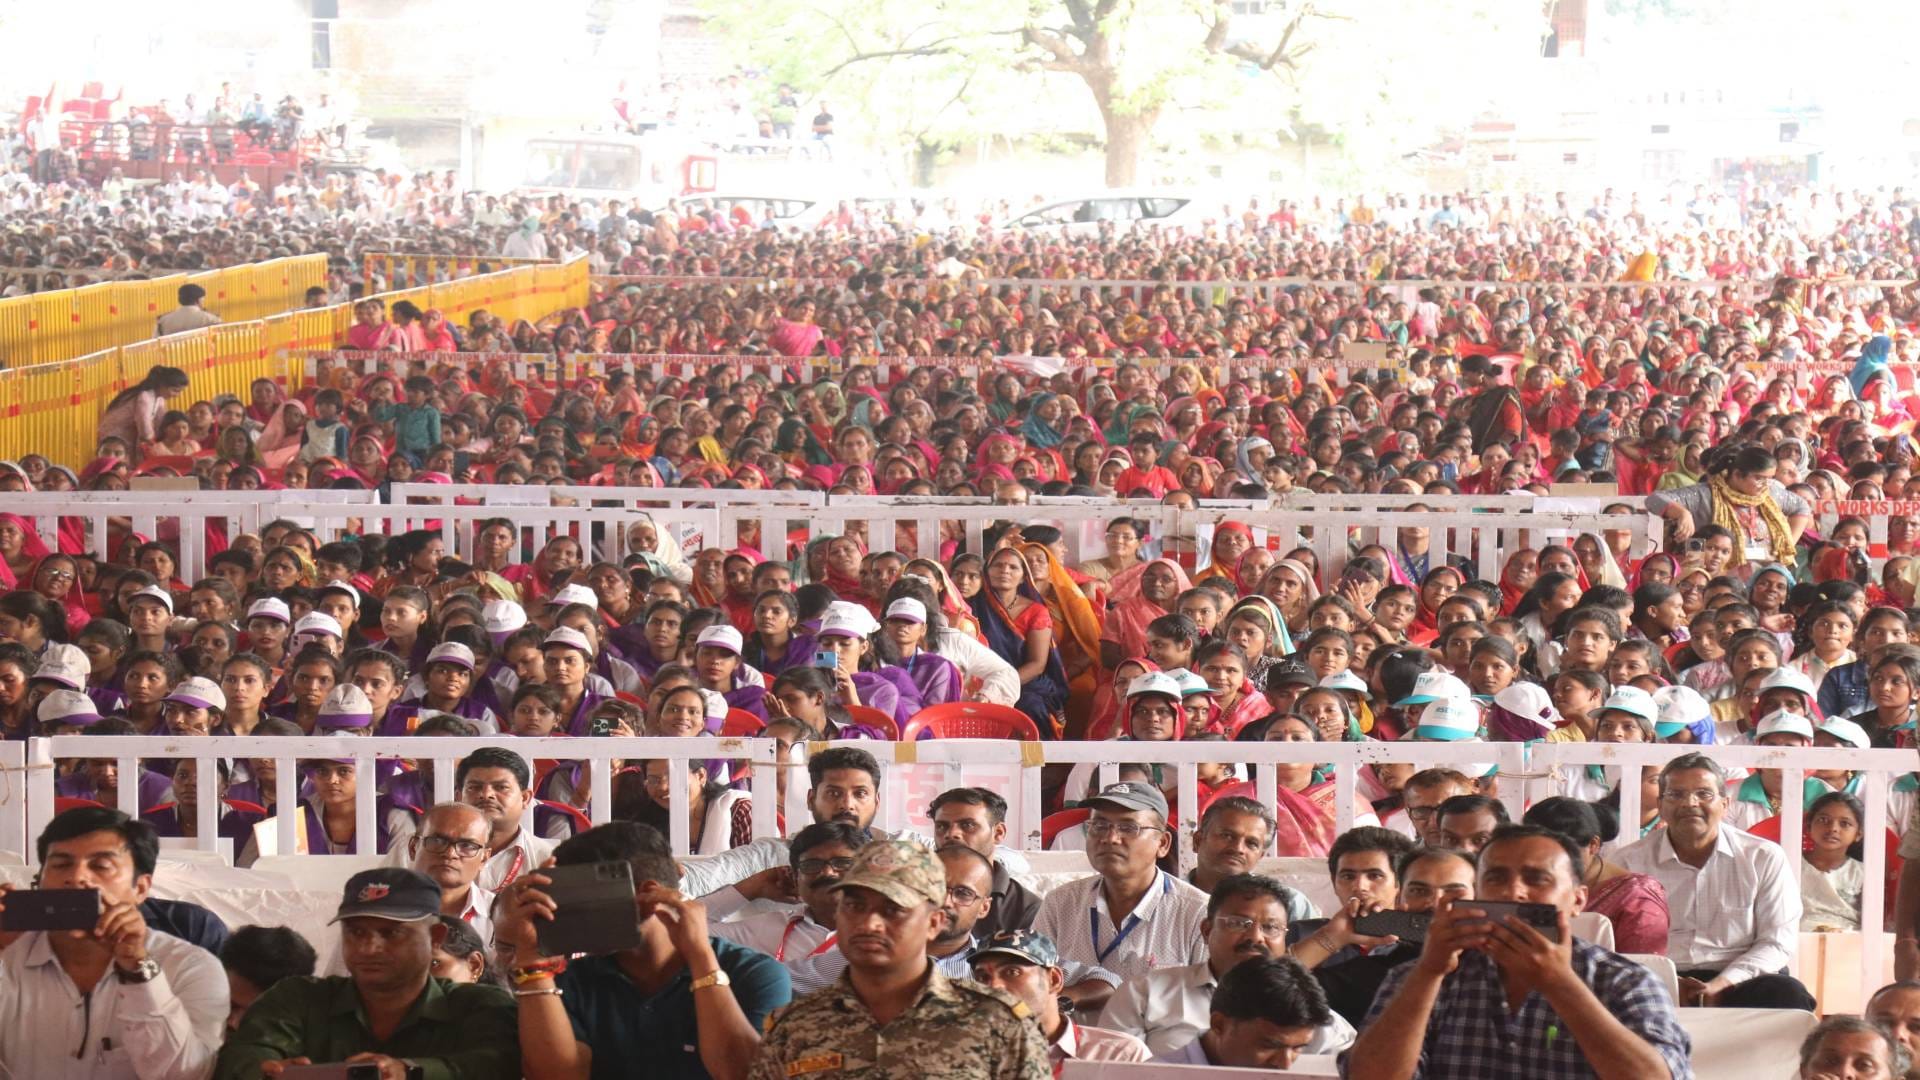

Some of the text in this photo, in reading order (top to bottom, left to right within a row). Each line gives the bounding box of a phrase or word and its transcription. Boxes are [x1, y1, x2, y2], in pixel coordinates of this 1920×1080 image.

[307, 351, 336, 359] PUBLIC
[344, 351, 374, 360] WORKS
[378, 351, 435, 361] DEPARTMENT
[1767, 361, 1801, 371] PUBLIC
[1807, 362, 1843, 372] WORKS
[1837, 500, 1888, 516] WORKS
